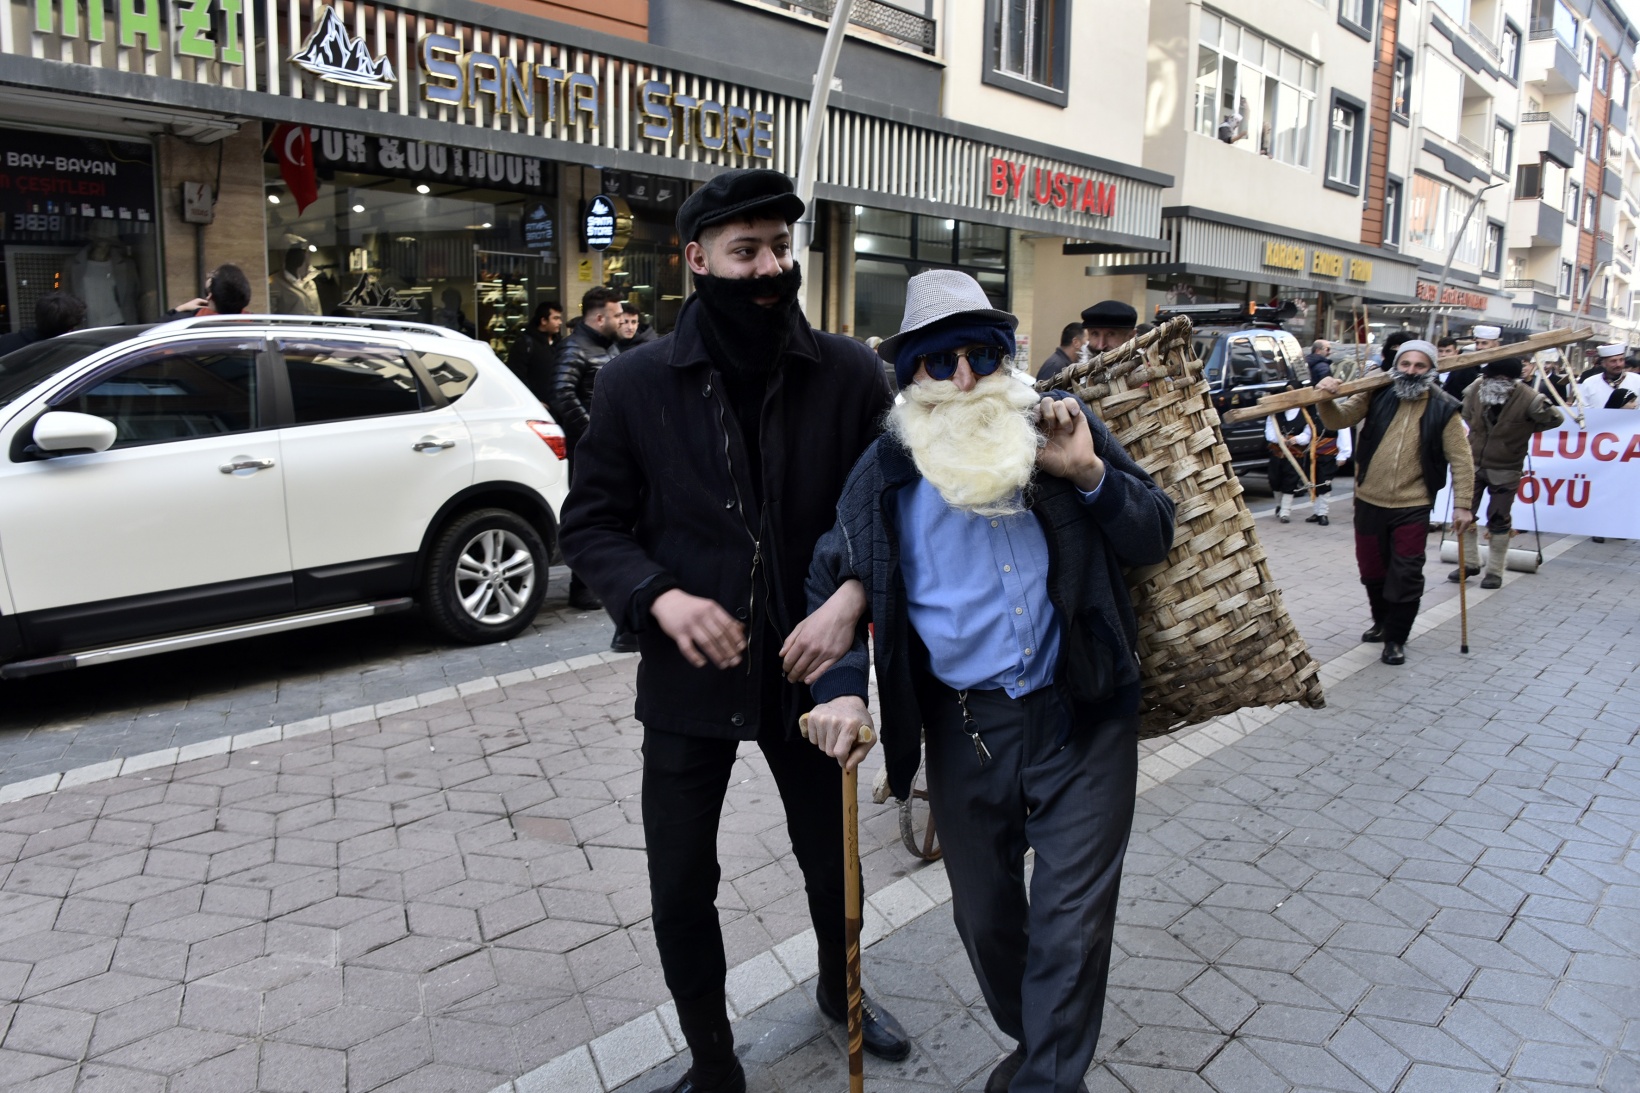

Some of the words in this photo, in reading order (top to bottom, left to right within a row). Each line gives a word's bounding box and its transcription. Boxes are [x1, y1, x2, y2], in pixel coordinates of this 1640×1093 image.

[421, 33, 599, 129] SANTA
[640, 79, 774, 159] STORE
[6, 151, 117, 176] BAY-BAYAN
[991, 157, 1026, 199] BY
[1035, 167, 1116, 217] USTAM
[587, 216, 613, 227] SANTA
[587, 226, 613, 236] STORE
